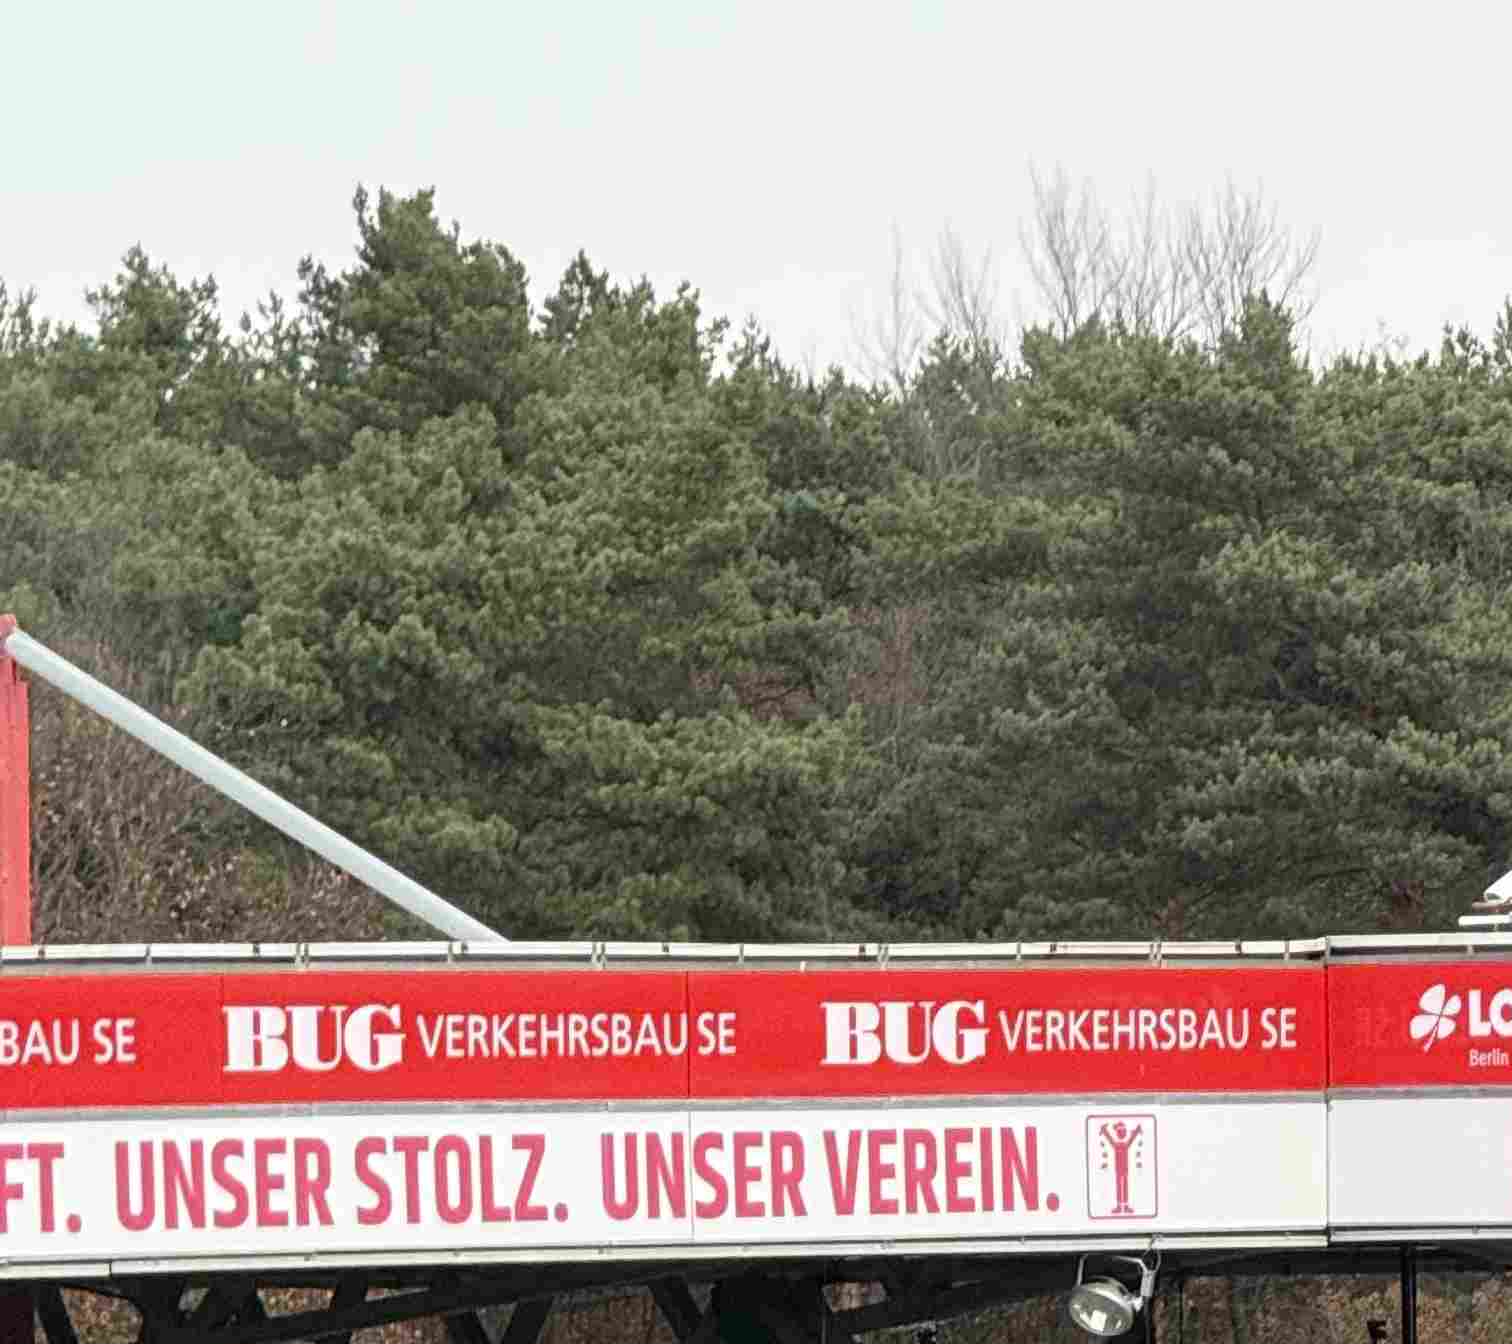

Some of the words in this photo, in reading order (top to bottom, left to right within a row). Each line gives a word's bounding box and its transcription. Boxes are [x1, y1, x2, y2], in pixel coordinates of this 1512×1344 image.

[93, 1017, 137, 1064] SE
[223, 1003, 406, 1074] BUG
[417, 1012, 688, 1058] VERKEHRSBAU
[696, 1012, 736, 1056] SE
[820, 1001, 990, 1066] BUG
[999, 1008, 1250, 1052] VERKEHRSBAU
[1260, 1007, 1297, 1049] SE
[1469, 1049, 1510, 1066] Berlin
[114, 1137, 332, 1231] UNSER
[354, 1134, 569, 1226] STOLZ.
[601, 1130, 807, 1220] UNSER
[823, 1126, 1061, 1216] VEREIN.
